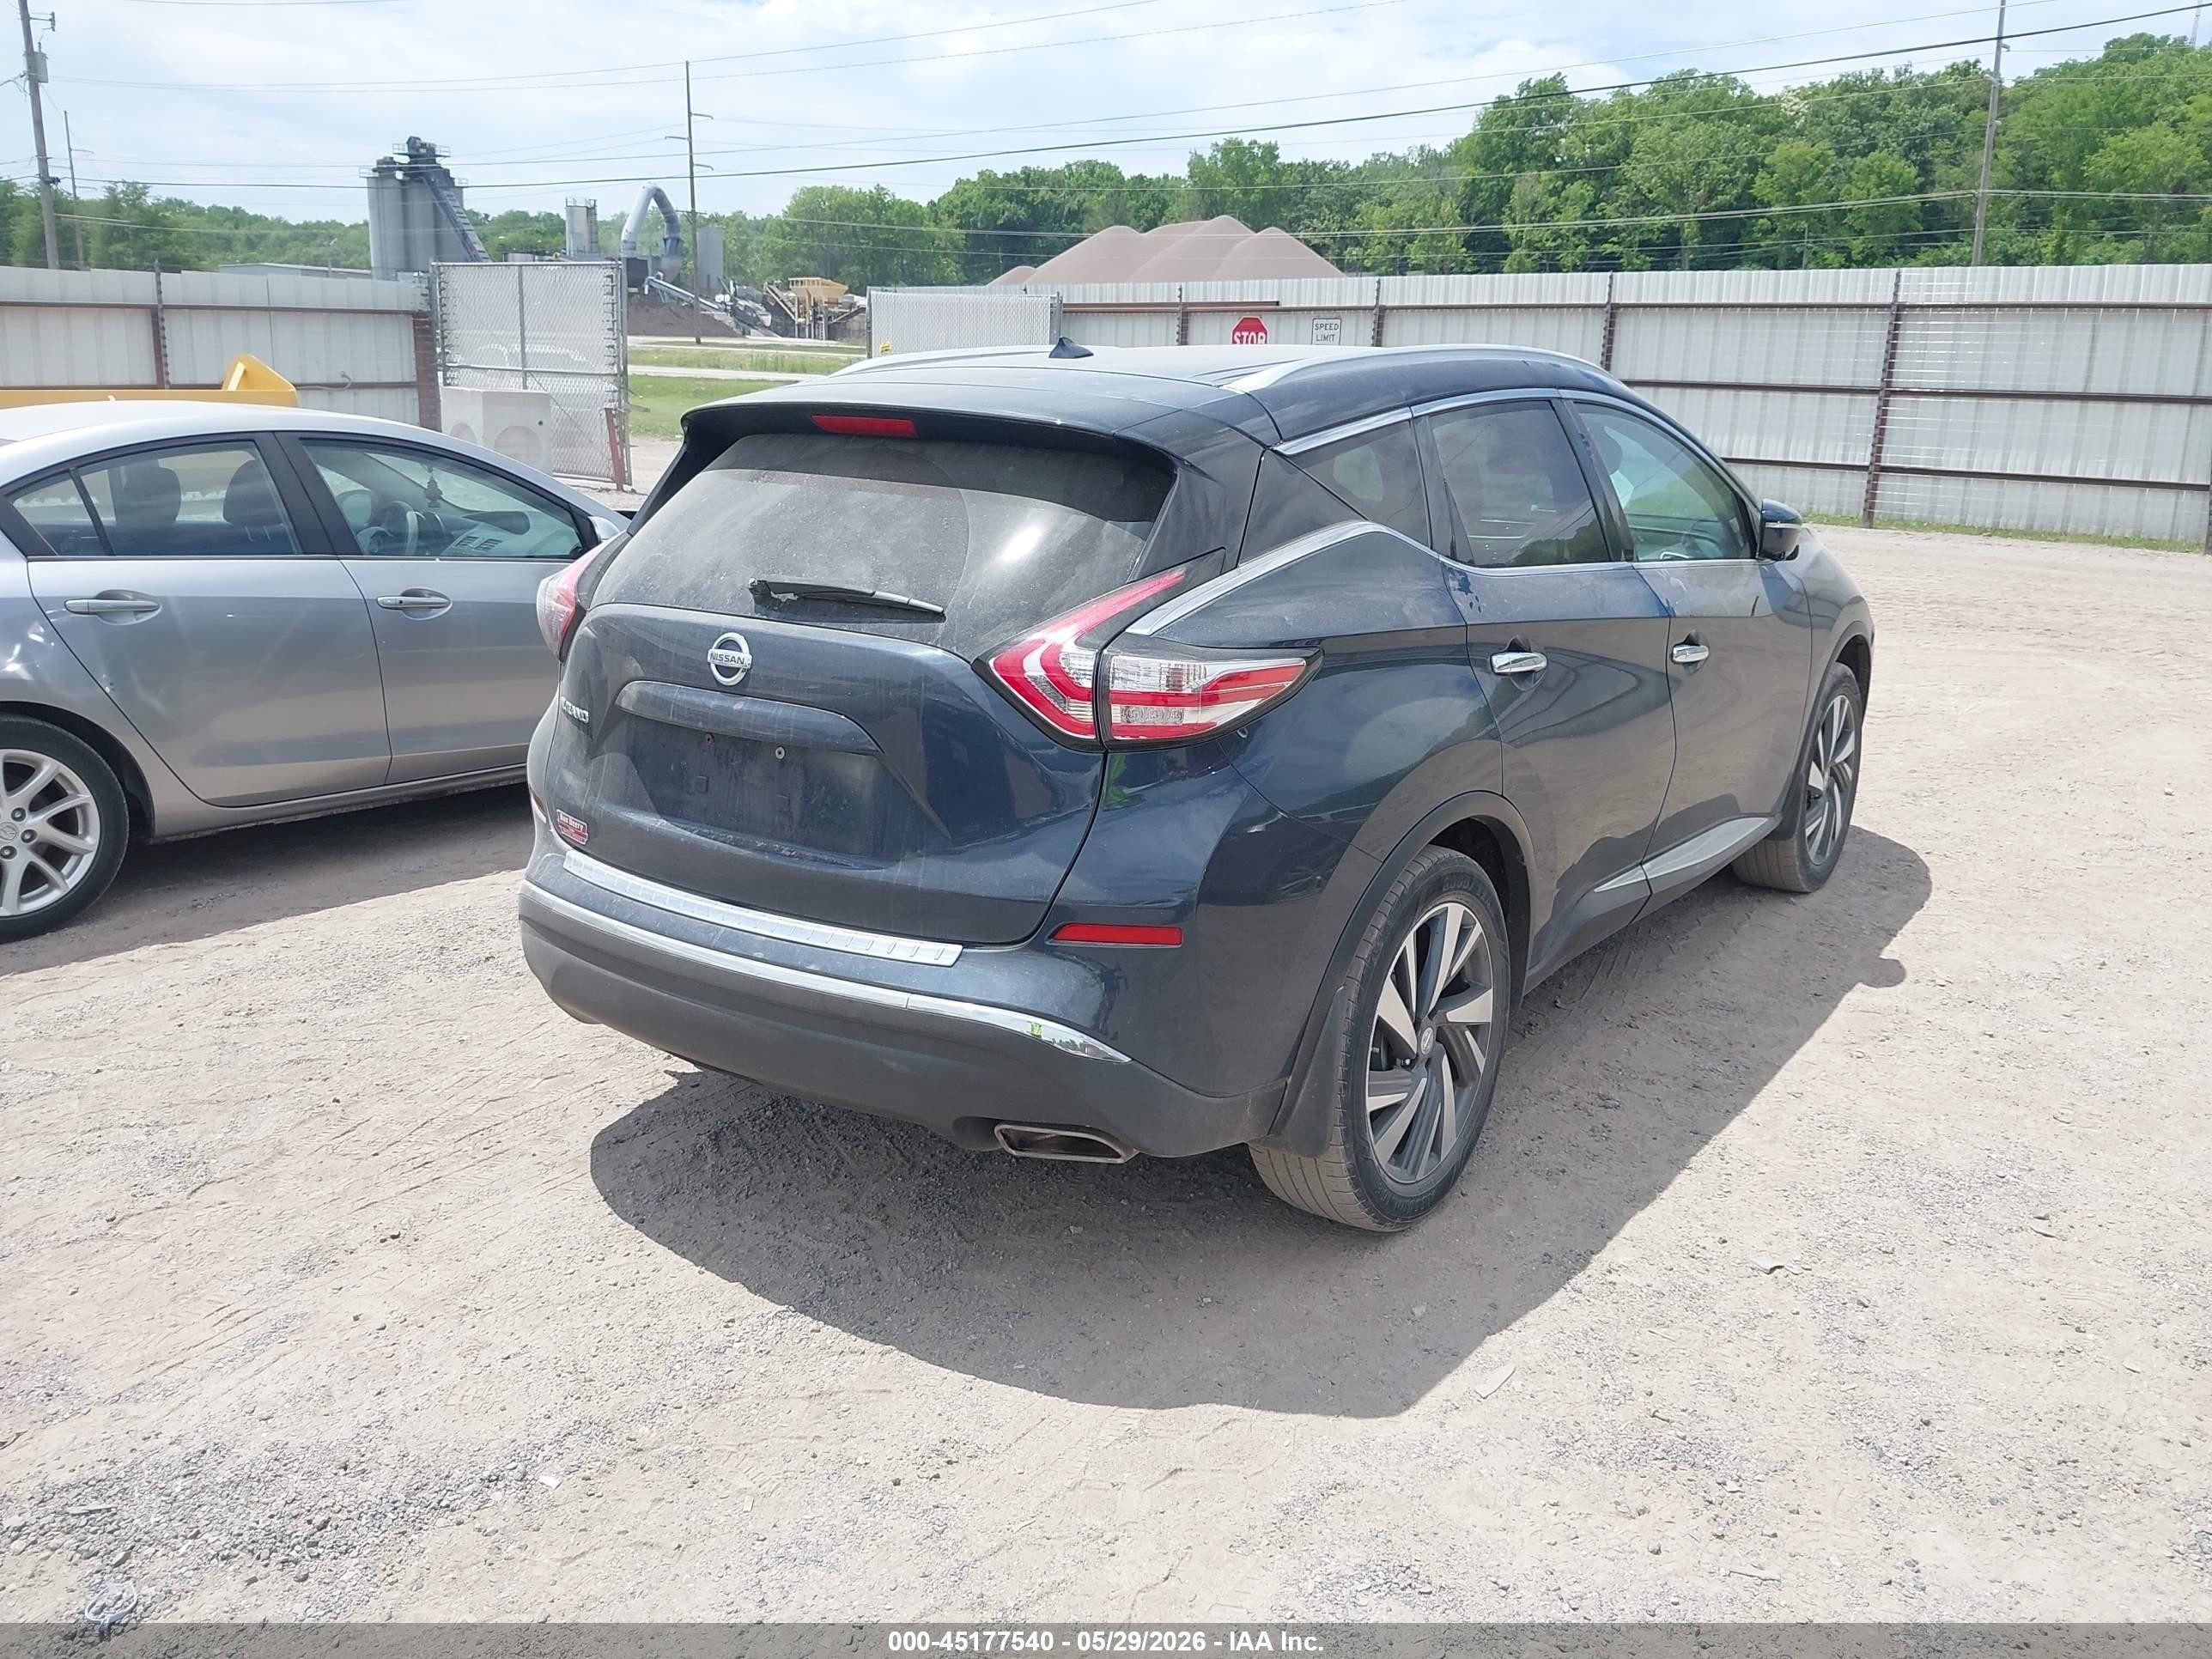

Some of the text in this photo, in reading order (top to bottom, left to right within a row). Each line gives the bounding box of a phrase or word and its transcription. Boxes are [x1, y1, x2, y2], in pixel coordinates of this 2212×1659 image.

[1314, 323, 1340, 331] SPEED
[1233, 331, 1267, 345] STOP
[1316, 333, 1336, 343] LIMIT
[709, 652, 745, 665] NISSAN
